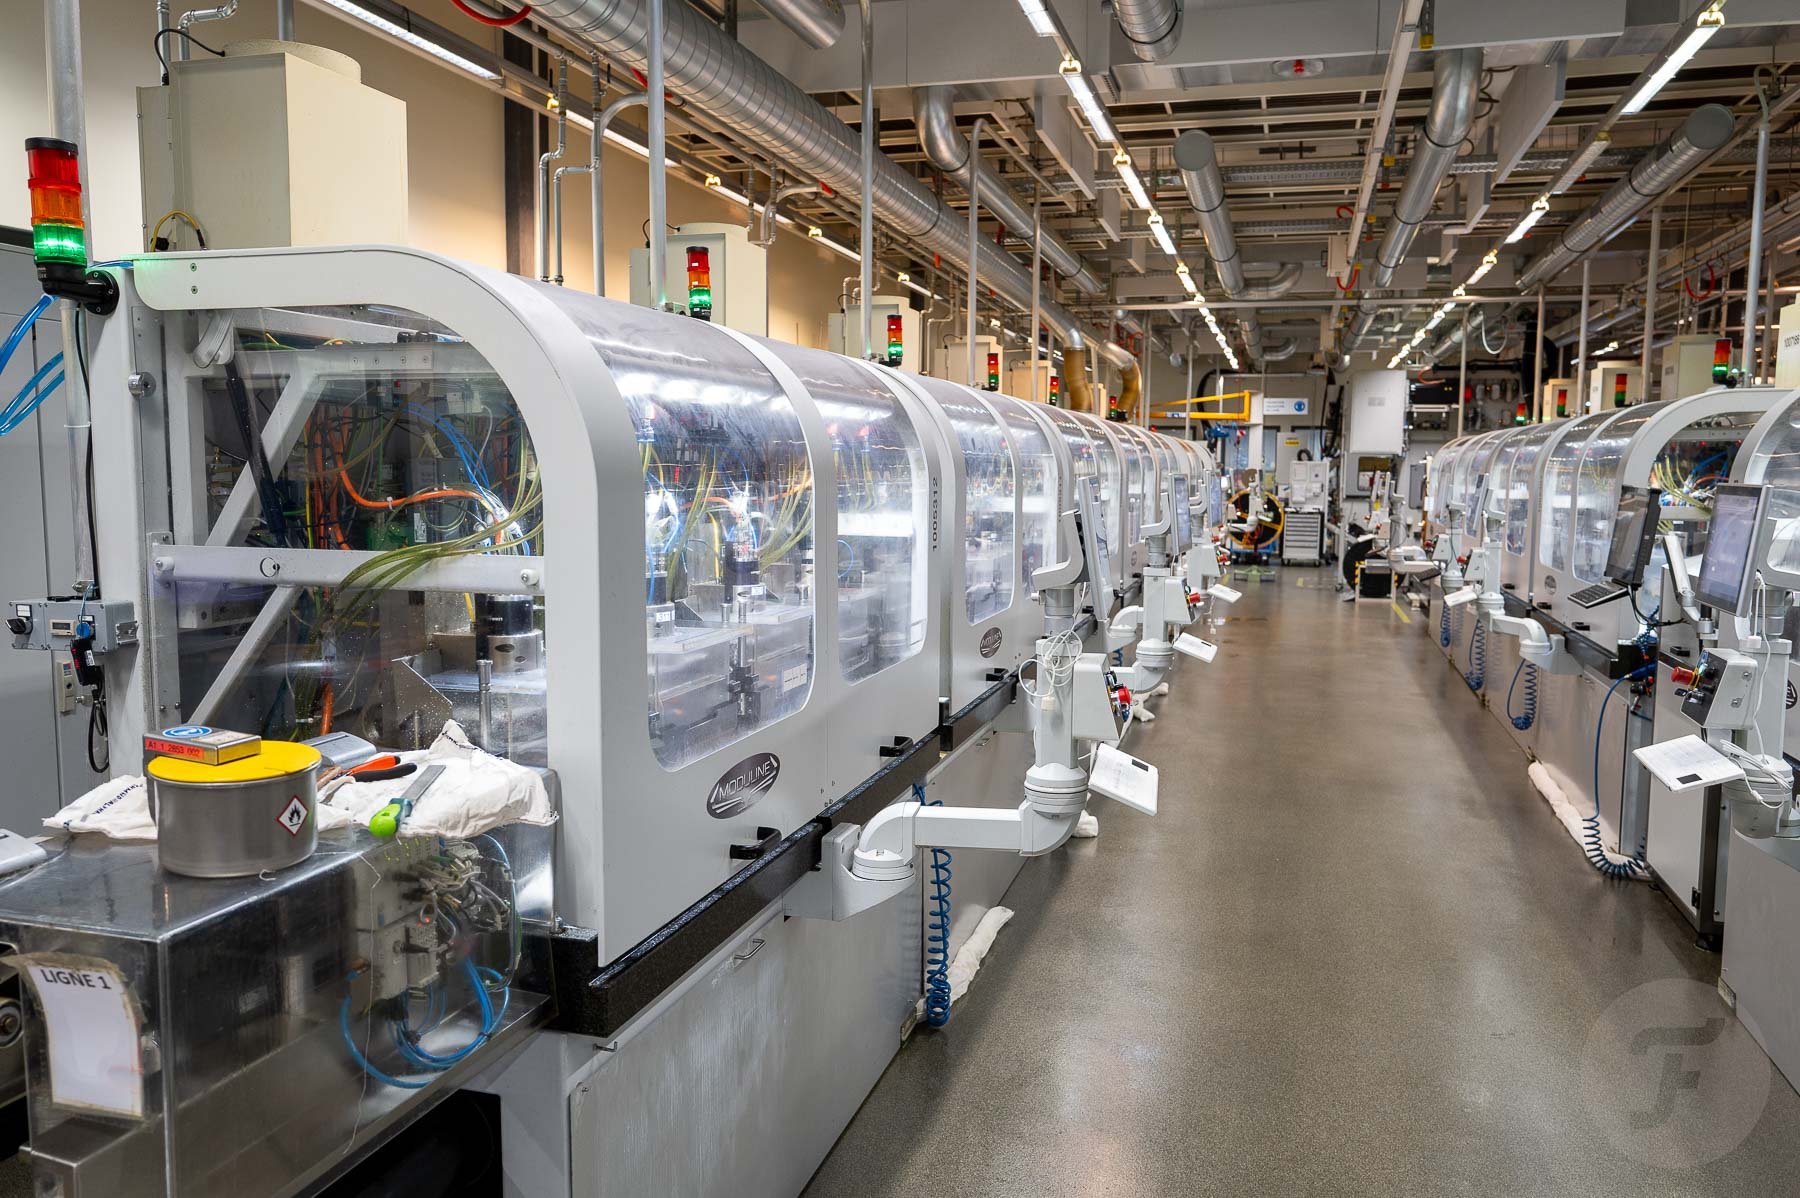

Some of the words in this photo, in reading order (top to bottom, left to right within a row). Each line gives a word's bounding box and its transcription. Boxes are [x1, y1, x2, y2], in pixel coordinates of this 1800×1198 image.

[719, 760, 771, 801] MODULINE
[40, 969, 96, 988] LIGNE
[97, 975, 112, 990] 1
